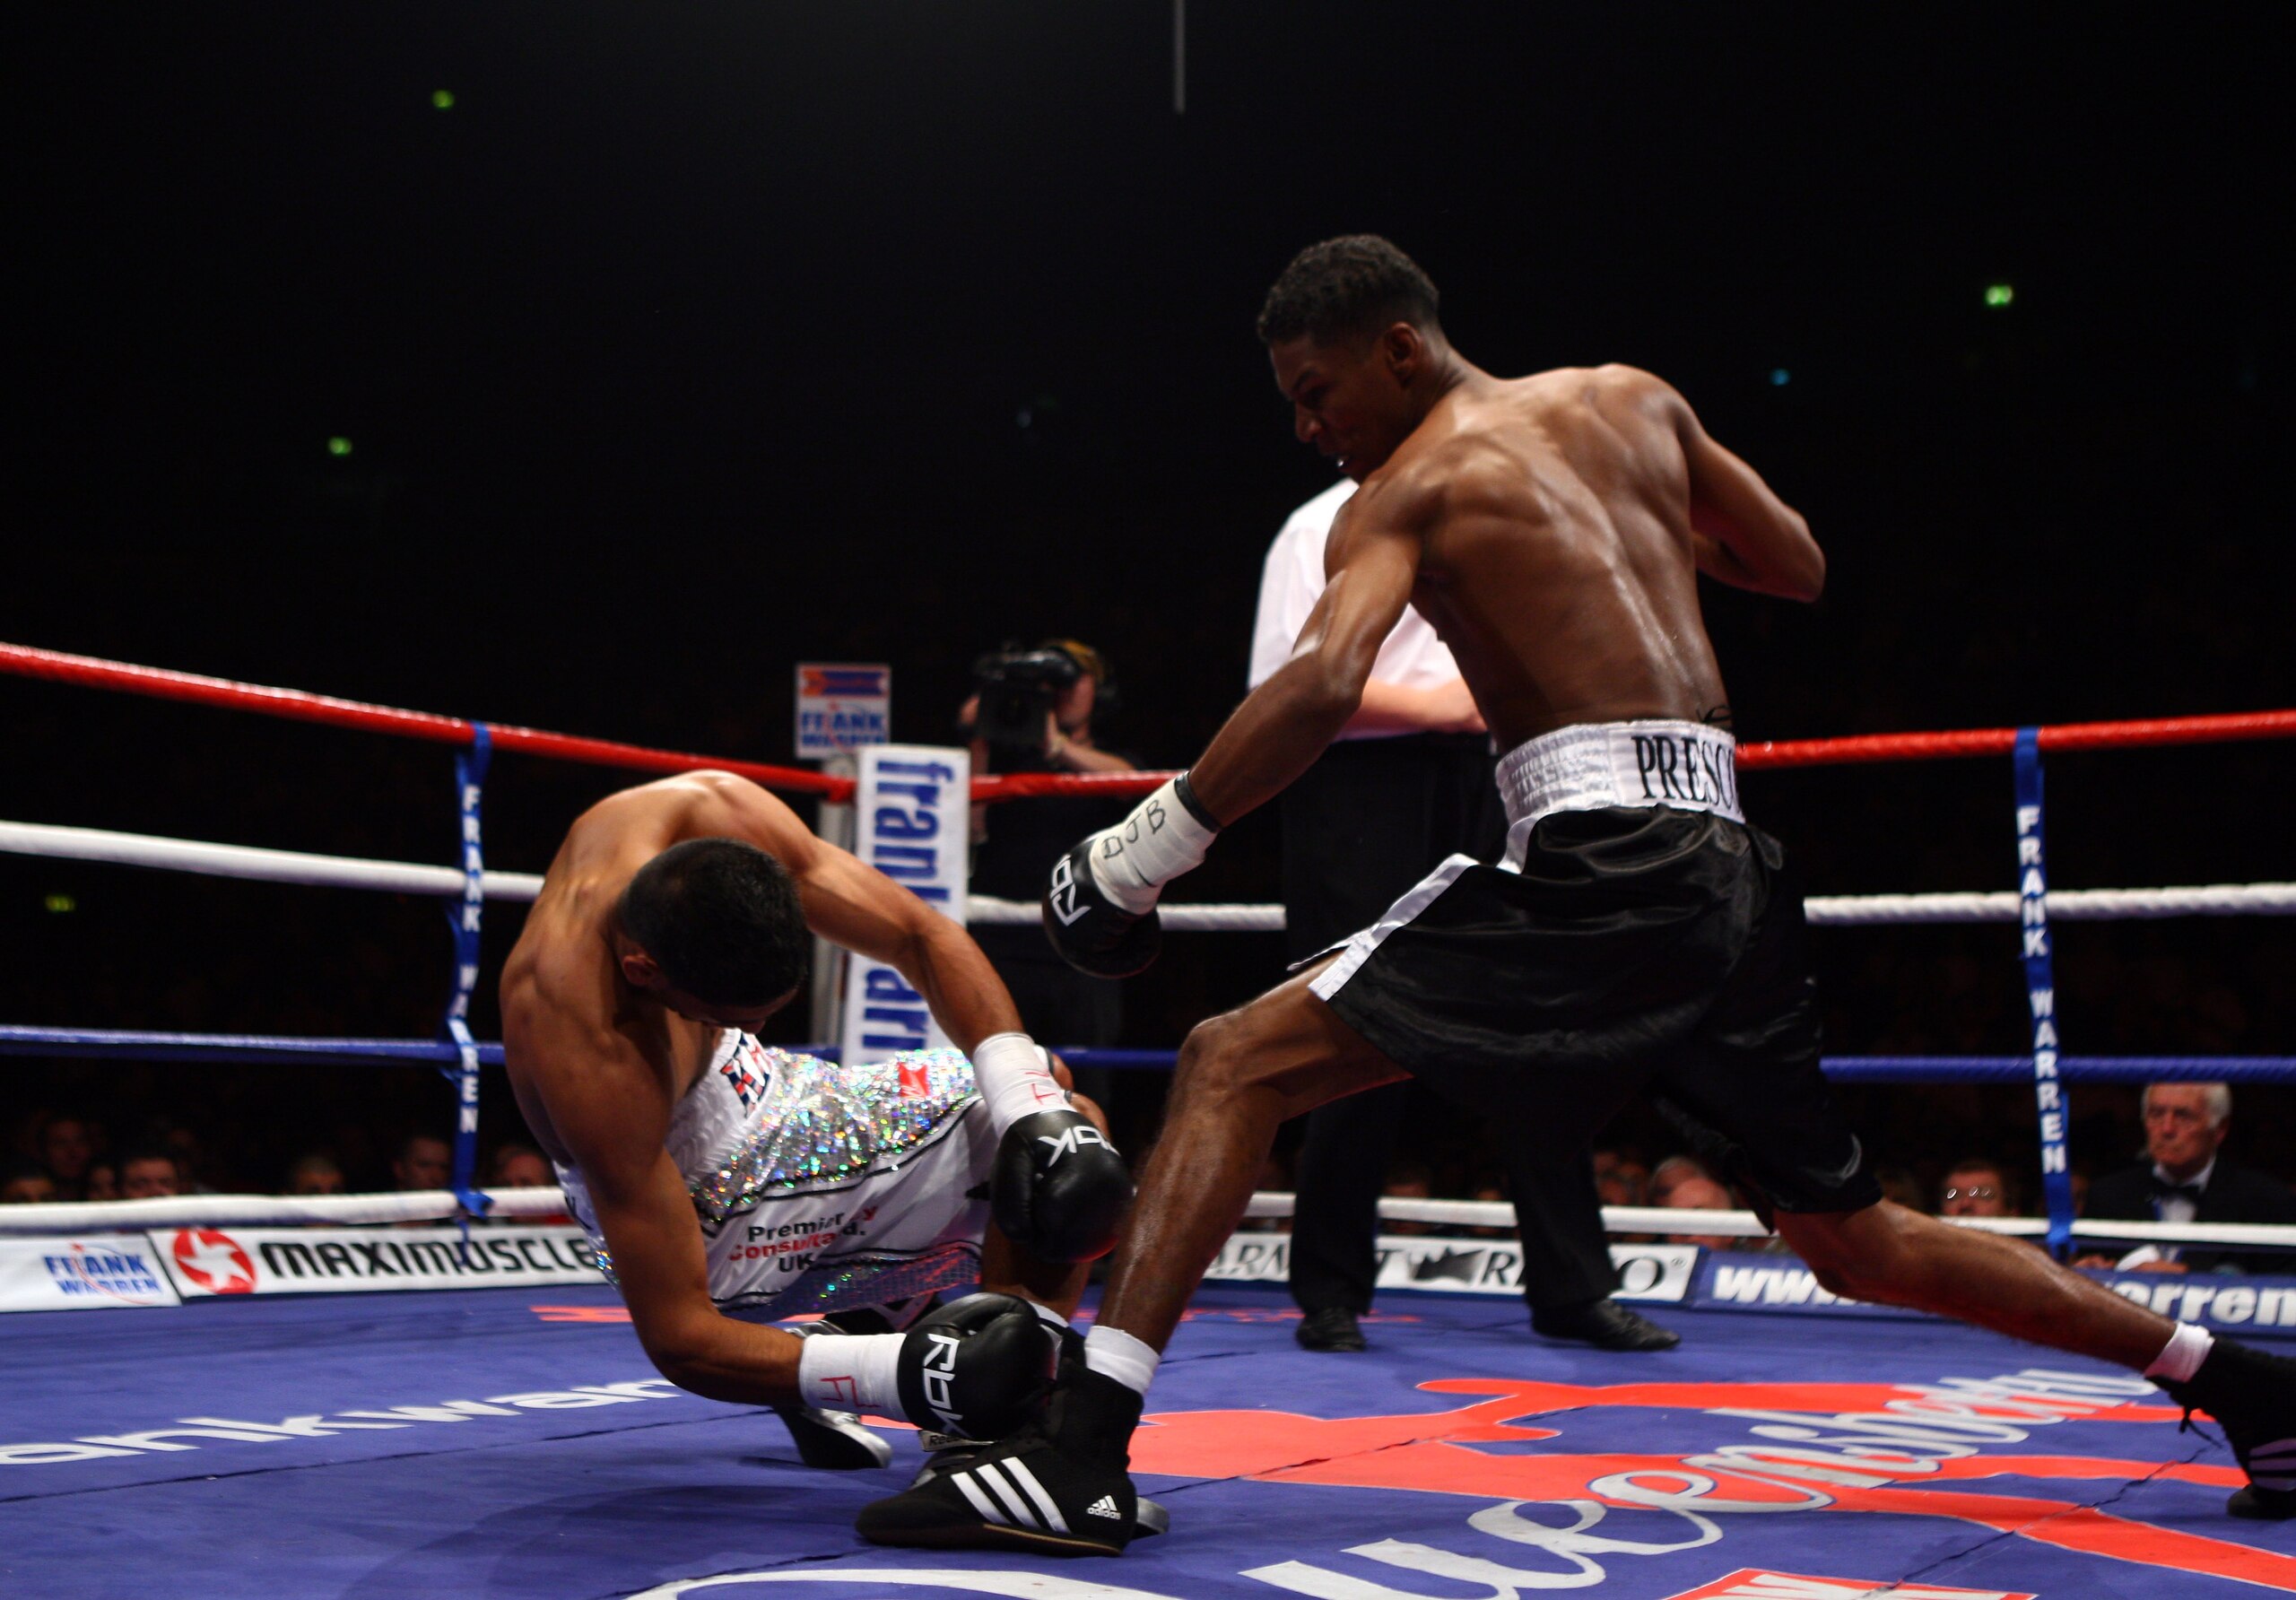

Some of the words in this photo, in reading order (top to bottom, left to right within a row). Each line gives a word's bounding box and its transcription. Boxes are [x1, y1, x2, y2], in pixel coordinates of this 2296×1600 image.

[2016, 805, 2049, 959] FRANK
[2030, 988, 2067, 1175] WARREN
[258, 1237, 598, 1278] MAXIMUSCLE
[1085, 1507, 1122, 1520] adidas
